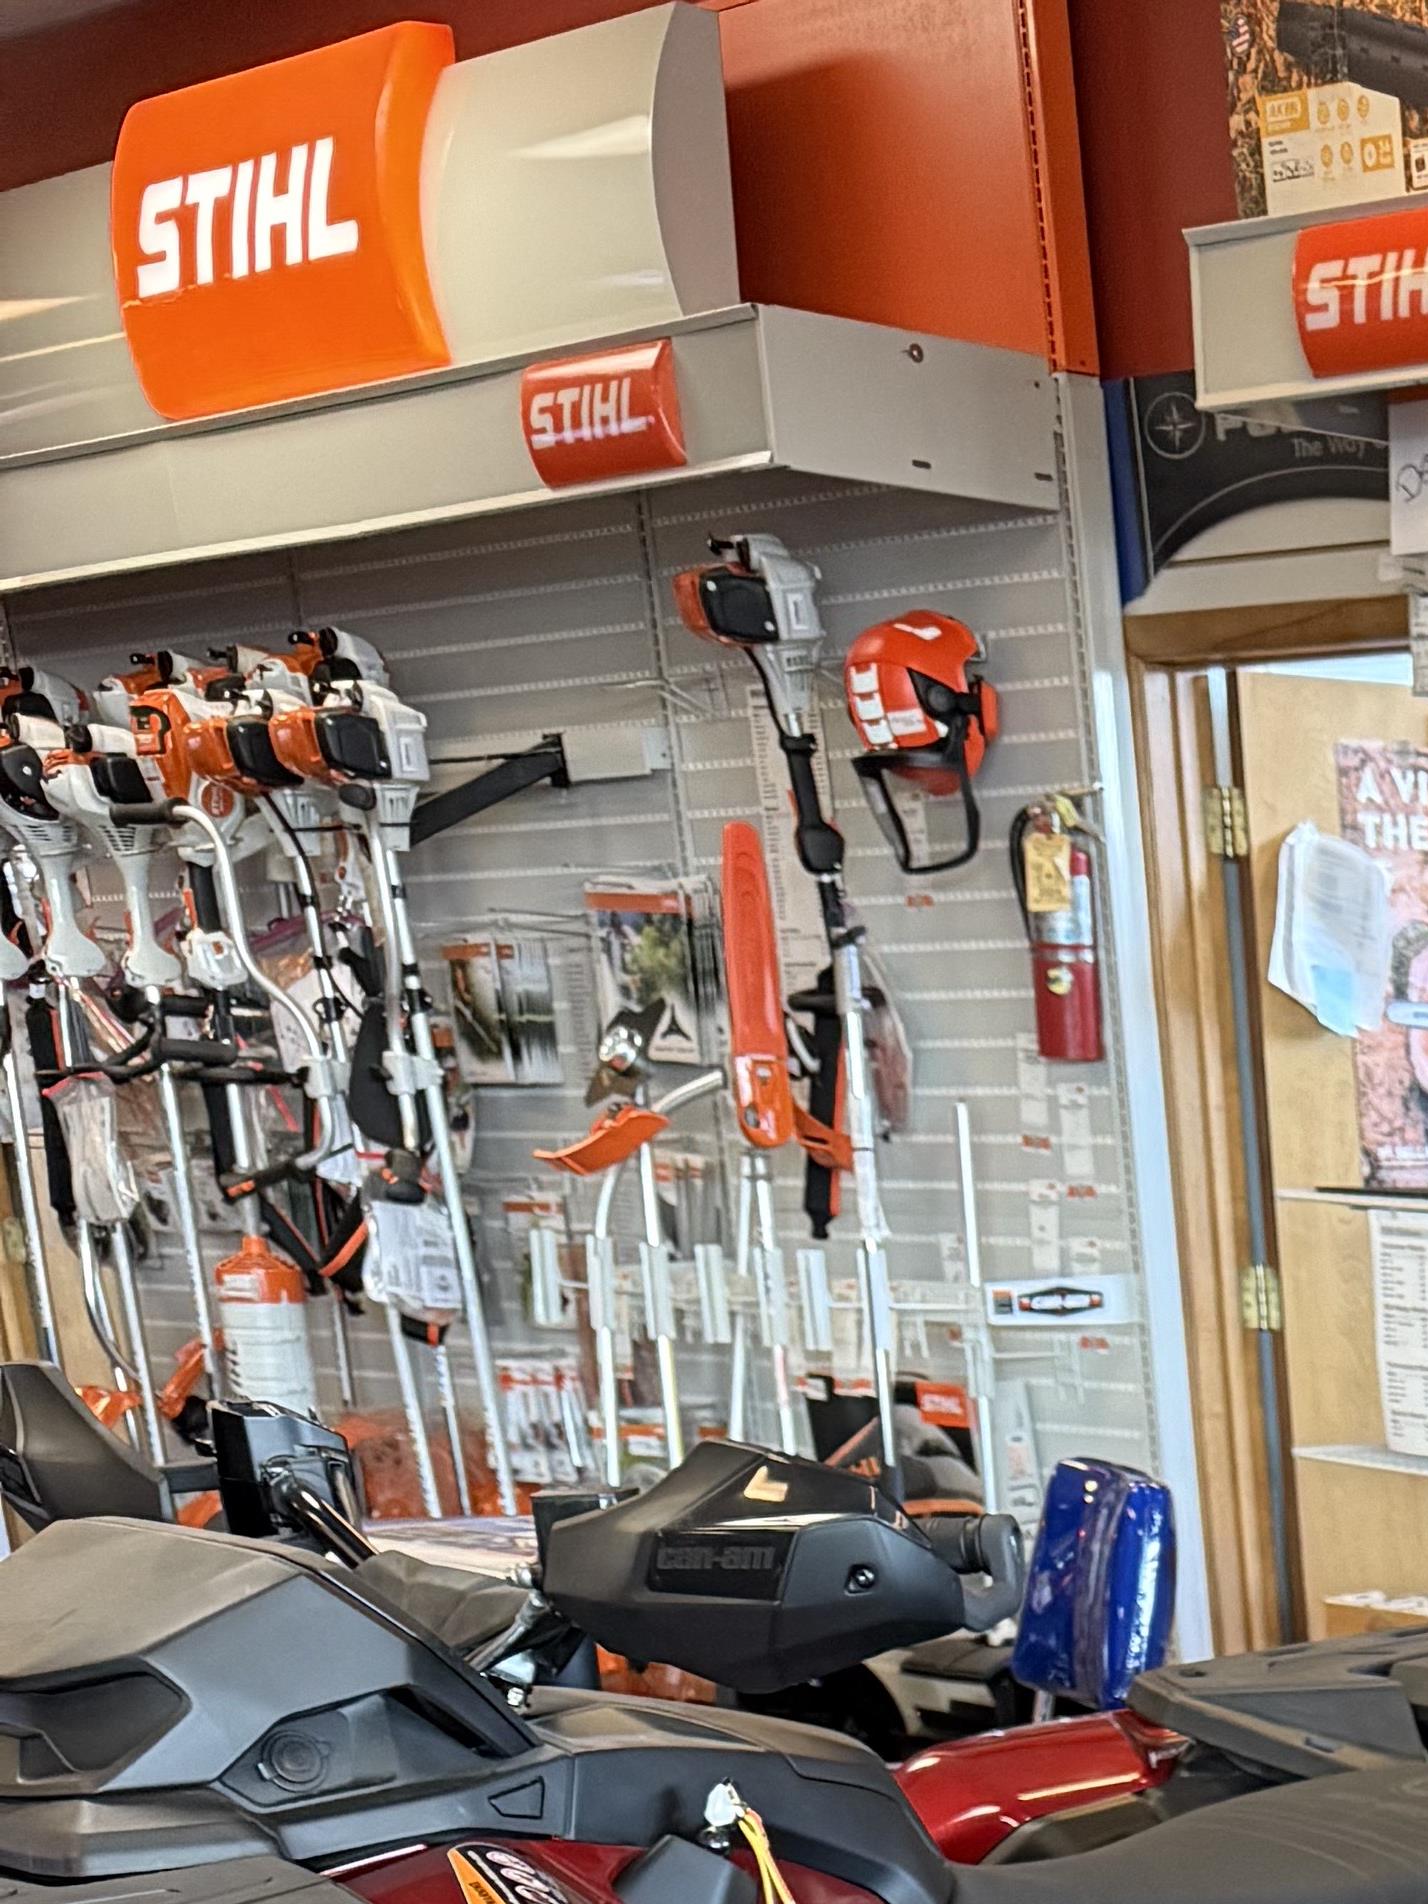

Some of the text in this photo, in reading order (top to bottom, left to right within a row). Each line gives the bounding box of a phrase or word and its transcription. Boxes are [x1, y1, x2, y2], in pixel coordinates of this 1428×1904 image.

[137, 136, 359, 299] STIHL
[530, 378, 649, 450] STIHL
[1292, 438, 1323, 458] The
[1328, 437, 1367, 460] Way
[1355, 766, 1384, 804] A
[655, 1545, 777, 1571] can-am
